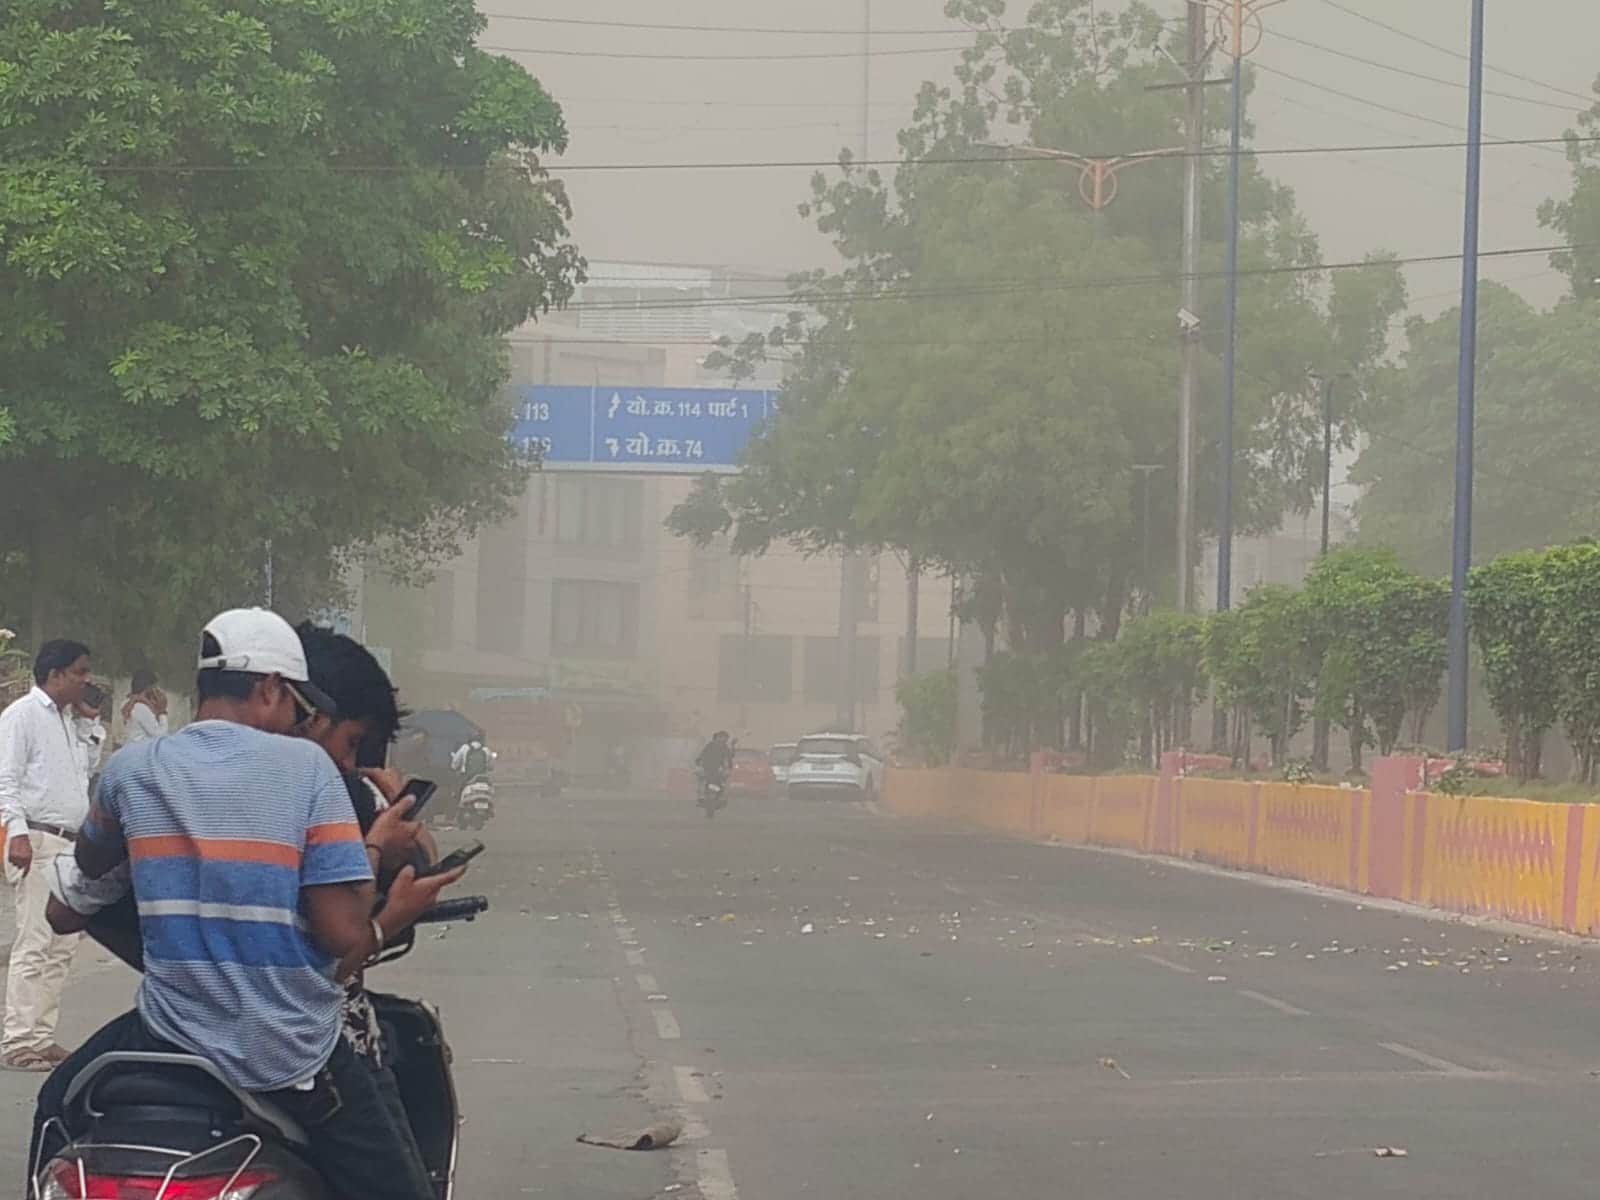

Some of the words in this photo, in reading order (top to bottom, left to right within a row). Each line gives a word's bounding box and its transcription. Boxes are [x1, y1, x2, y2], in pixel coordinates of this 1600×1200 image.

[523, 402, 549, 421] 113
[707, 397, 738, 418] पार्ट
[741, 402, 749, 419] 1
[684, 439, 702, 457] 74
